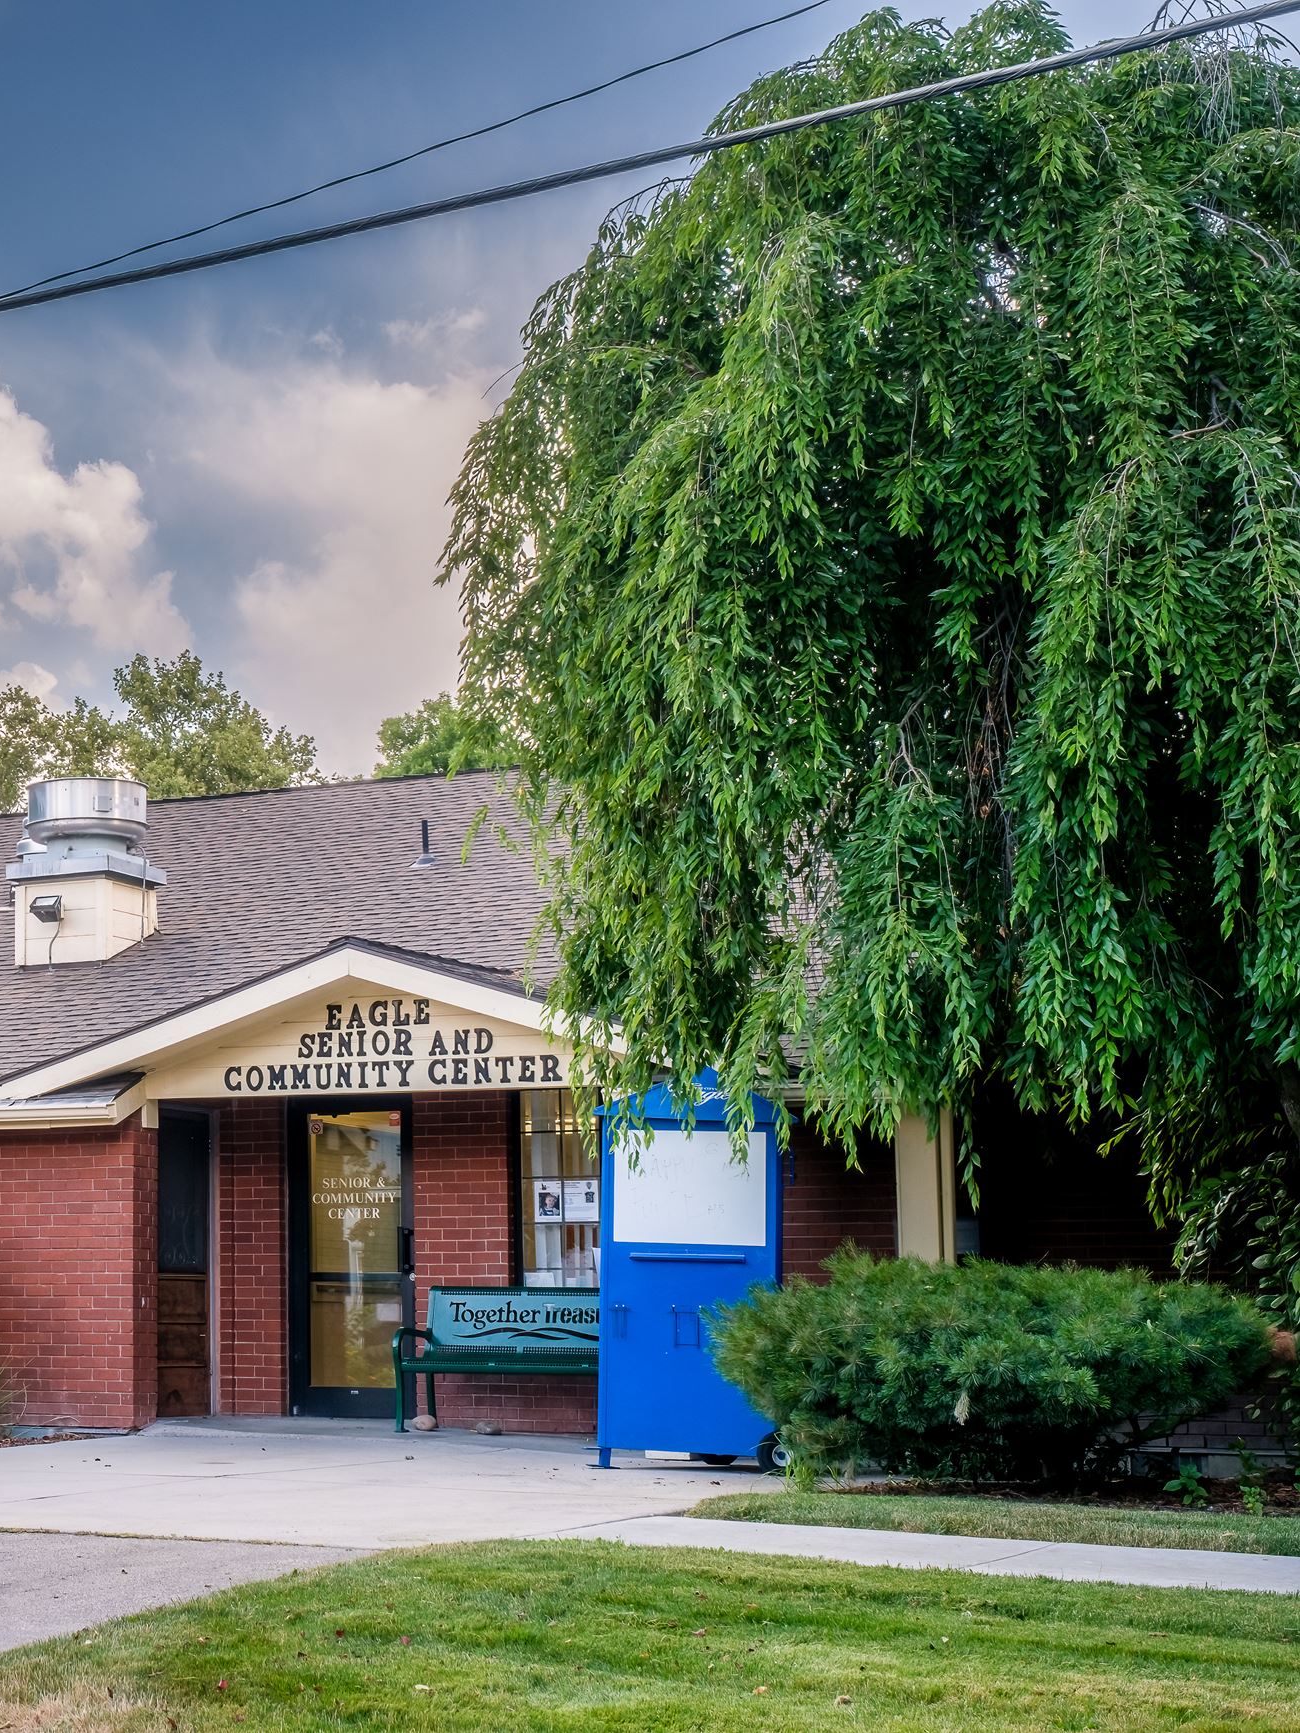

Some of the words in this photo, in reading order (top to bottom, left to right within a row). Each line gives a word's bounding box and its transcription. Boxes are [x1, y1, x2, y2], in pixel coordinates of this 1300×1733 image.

[325, 999, 430, 1031] EAGLE
[297, 1028, 413, 1059] SENIOR
[428, 1028, 494, 1057] AND
[224, 1059, 415, 1092] COMMUNITY
[427, 1054, 563, 1085] CENTER
[322, 1177, 370, 1189] SENIOR
[376, 1176, 386, 1188] &
[312, 1192, 397, 1204] COMMUNITY
[328, 1207, 380, 1219] CENTER
[449, 1300, 541, 1330] Together
